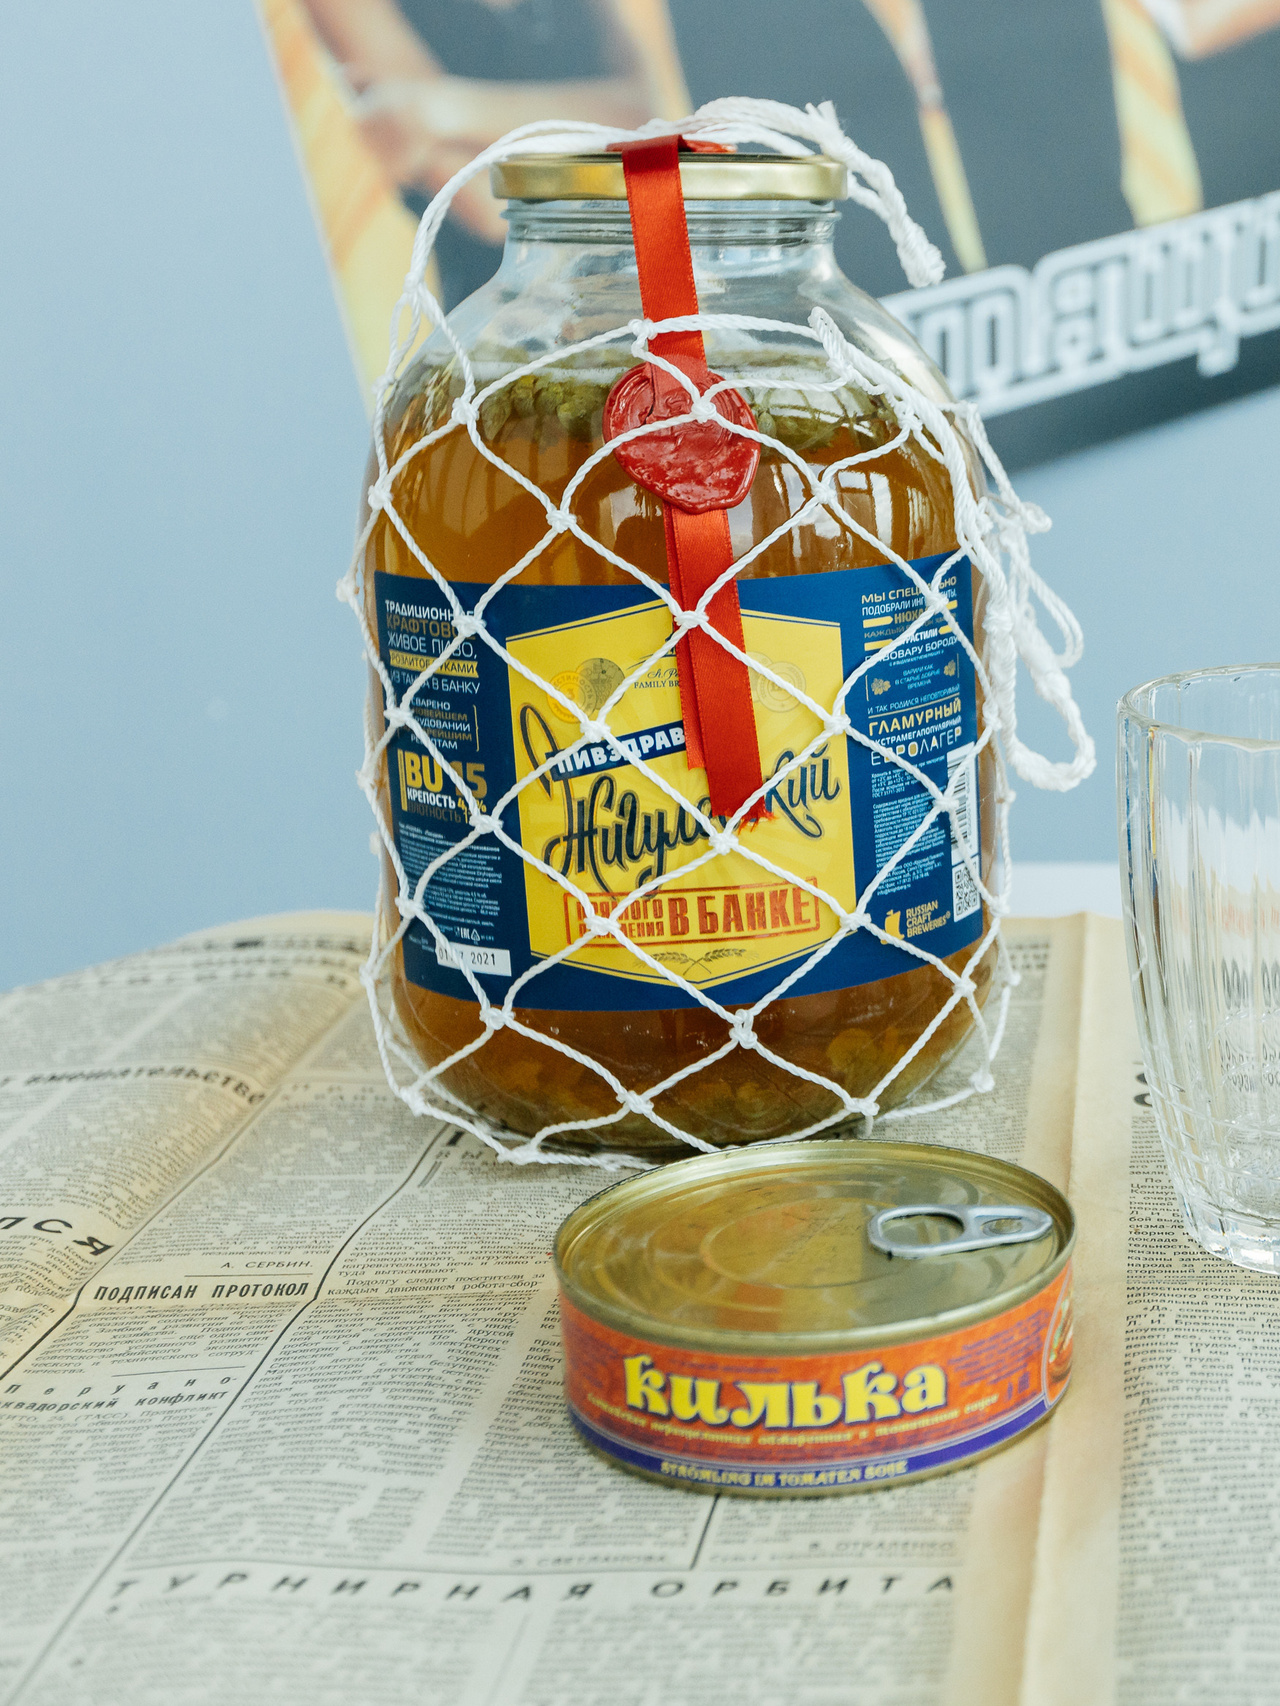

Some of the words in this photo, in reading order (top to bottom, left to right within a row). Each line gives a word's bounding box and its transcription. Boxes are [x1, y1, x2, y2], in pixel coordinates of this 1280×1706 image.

[861, 593, 886, 605] МЫ
[862, 598, 911, 616] ПОДОБРАЛИ
[387, 631, 427, 653] ЖИВОЕ
[390, 669, 400, 684] ИЗ
[431, 678, 439, 690] В
[441, 679, 480, 694] БАНКУ
[634, 680, 666, 689] FAMILY
[411, 697, 451, 710] СВАРЕНО
[867, 707, 873, 715] И
[875, 705, 888, 713] ТАК
[890, 697, 919, 711] РОДИЛСЯ
[920, 684, 960, 701] НЕПОВТОРИМЫЙ
[868, 697, 962, 737] ГЛАМУРНЫЙ
[407, 787, 456, 809] КРЕПОСТЬ
[668, 897, 690, 937] В
[698, 888, 811, 934] БАНКЕ
[906, 900, 939, 918] RUSSIAN
[906, 911, 932, 928] CRAFT
[471, 951, 496, 966] 2021
[220, 1261, 234, 1269] А.
[245, 1260, 313, 1269] СЕРБИН.
[327, 1287, 379, 1296] каждым
[385, 1284, 456, 1295] движением
[462, 1279, 543, 1291] робота-сбор-
[346, 1278, 399, 1287] Подолгу
[405, 1276, 447, 1285] следят
[455, 1274, 525, 1283] посетители
[93, 1285, 199, 1304] ПОДПИСАН
[211, 1282, 309, 1300] ПРОТОКОЛ
[1178, 1307, 1247, 1315] советские
[1214, 1301, 1280, 1309] прогресс.
[1175, 1313, 1257, 1322] завтрашний
[468, 1327, 514, 1338] другой
[1125, 1327, 1230, 1335] моуверенность
[463, 1334, 509, 1346] дороге
[135, 1391, 229, 1407] конфликт
[622, 1353, 947, 1430] килька
[112, 1573, 595, 1602] ТУРНИРНАЯ
[650, 1574, 955, 1598] ОРБИТА
